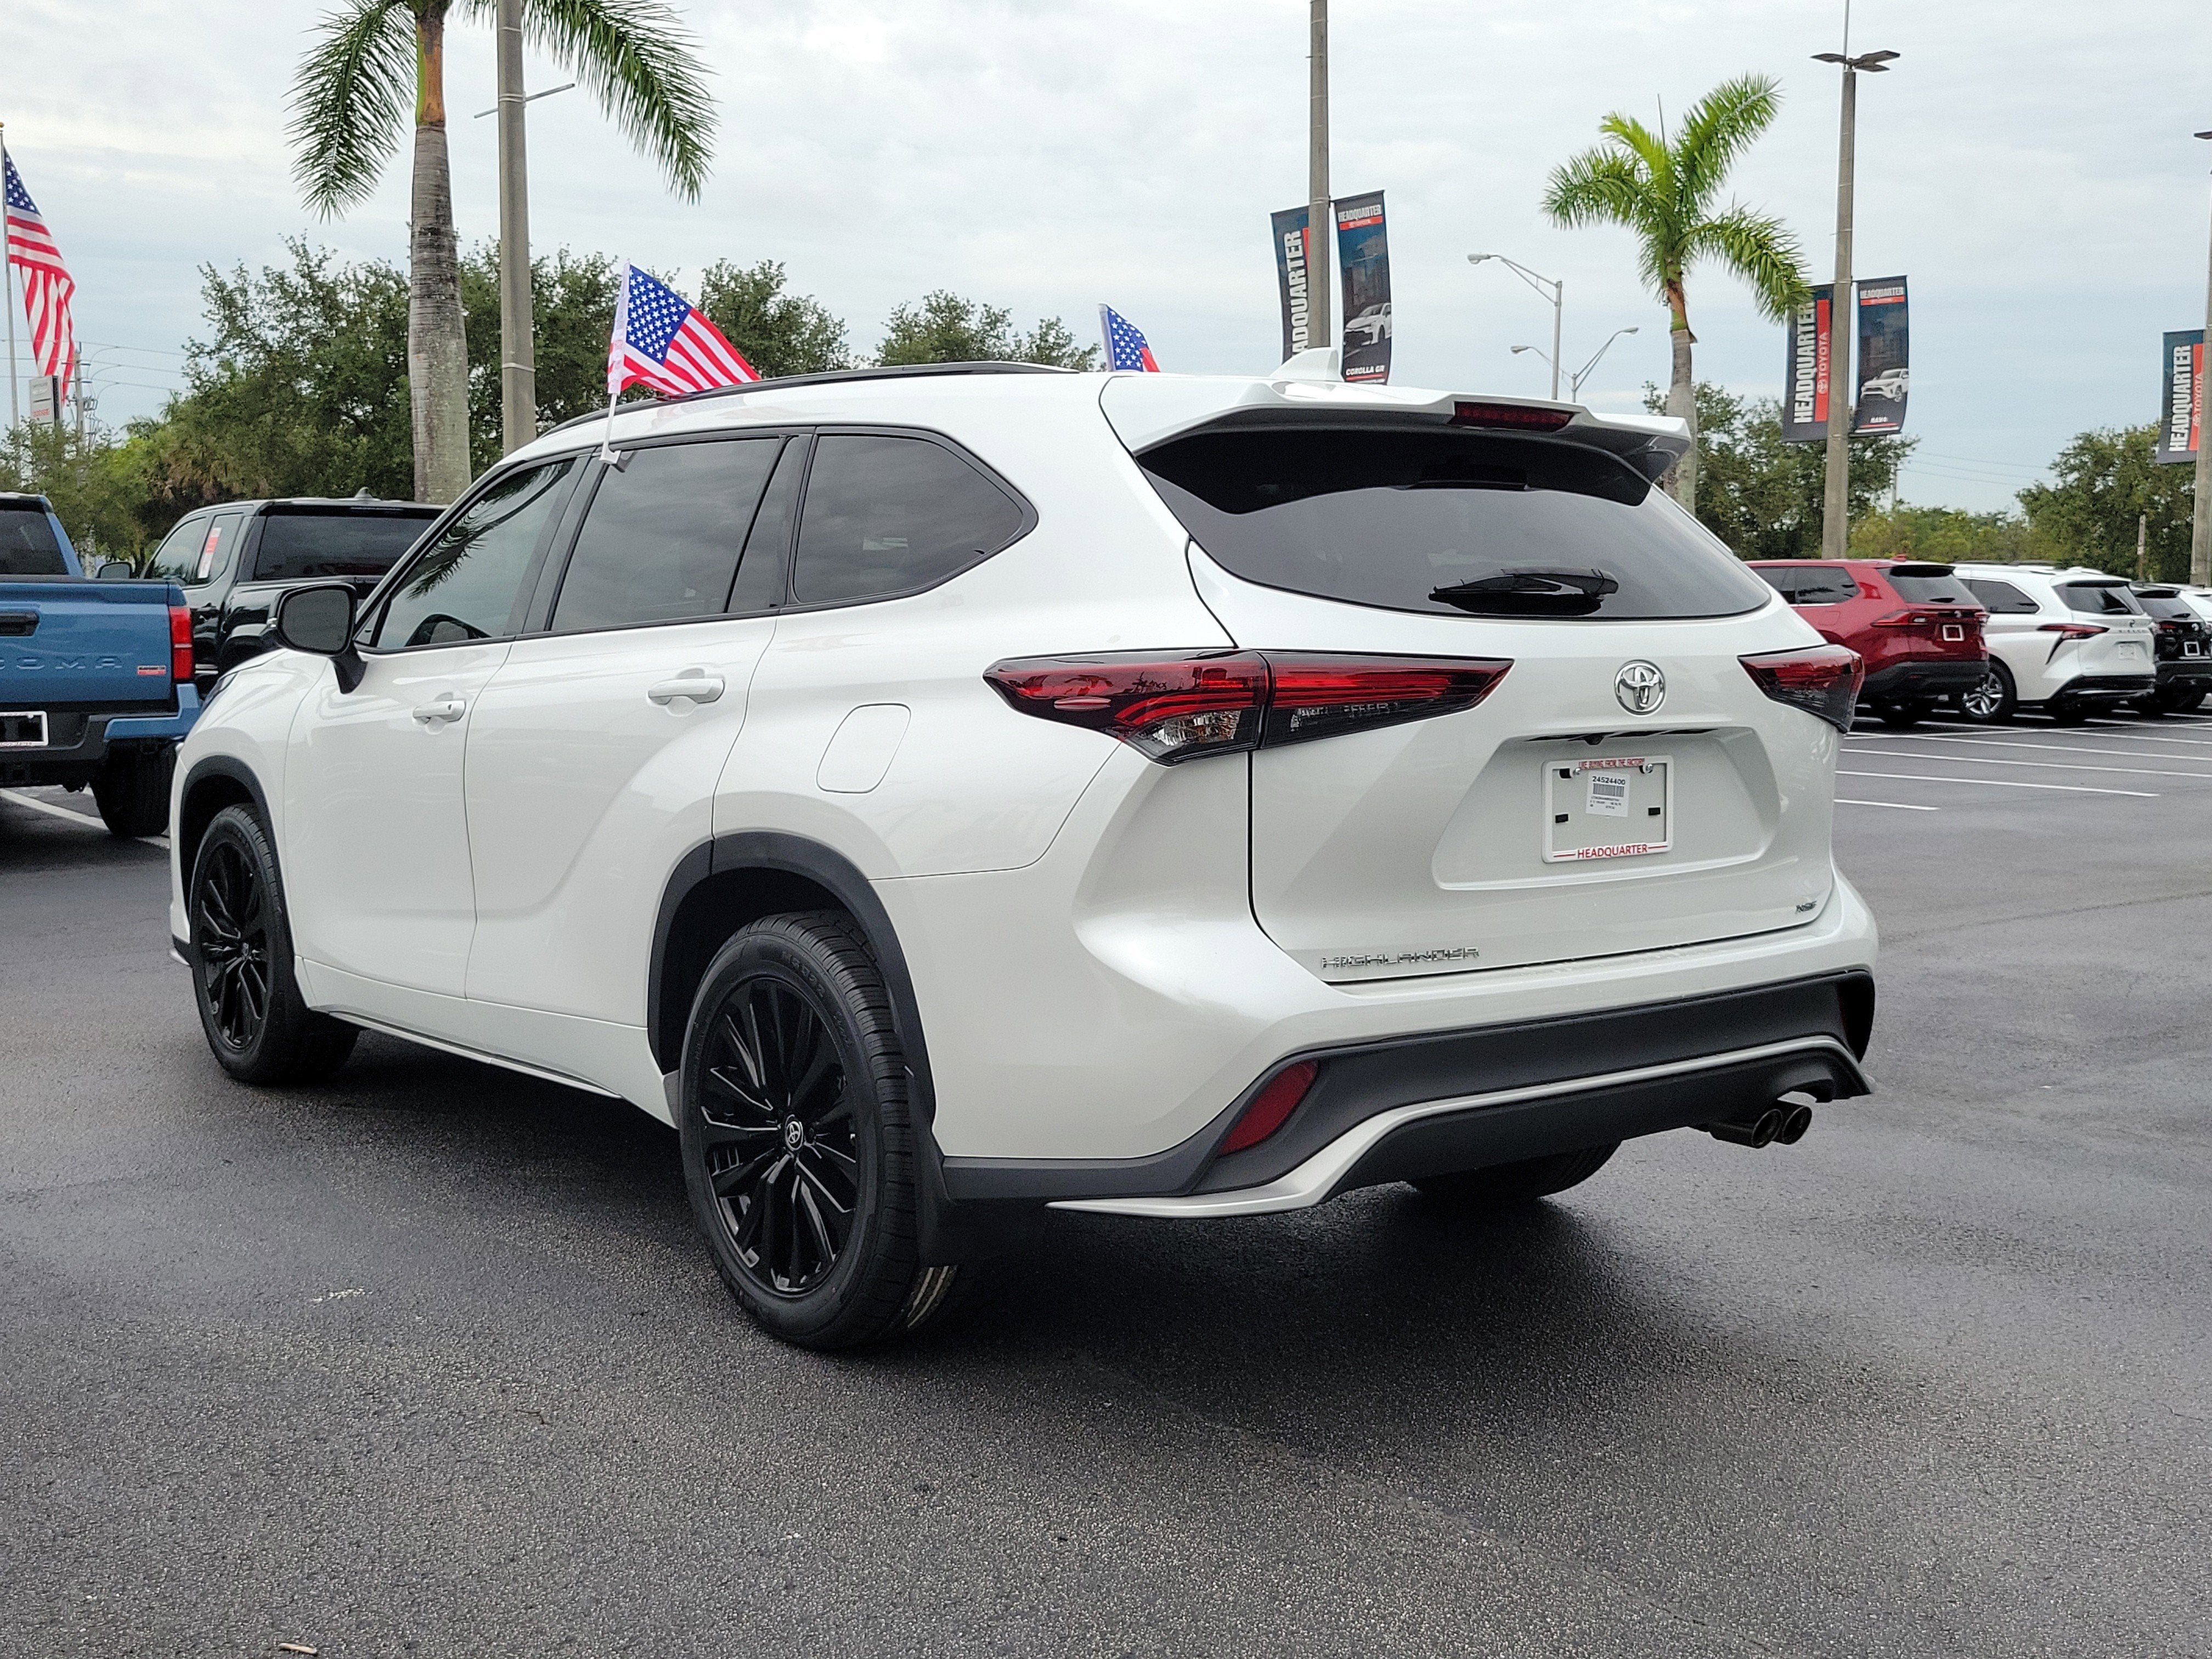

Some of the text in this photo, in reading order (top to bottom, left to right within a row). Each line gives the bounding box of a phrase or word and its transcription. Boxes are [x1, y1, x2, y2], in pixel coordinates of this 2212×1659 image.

[1284, 230, 1308, 353] ADQUARTER
[1793, 301, 1816, 423] HEADQUARTER
[1819, 332, 1829, 379] TOYOTA
[1346, 366, 1374, 376] COROLLA
[2169, 345, 2192, 452] HEADQUARTER
[0, 656, 122, 670] OMA
[1592, 776, 1626, 785] 24524400
[1577, 844, 1647, 859] HEADQUARTER
[1322, 947, 1480, 969] HIGHLANDER
